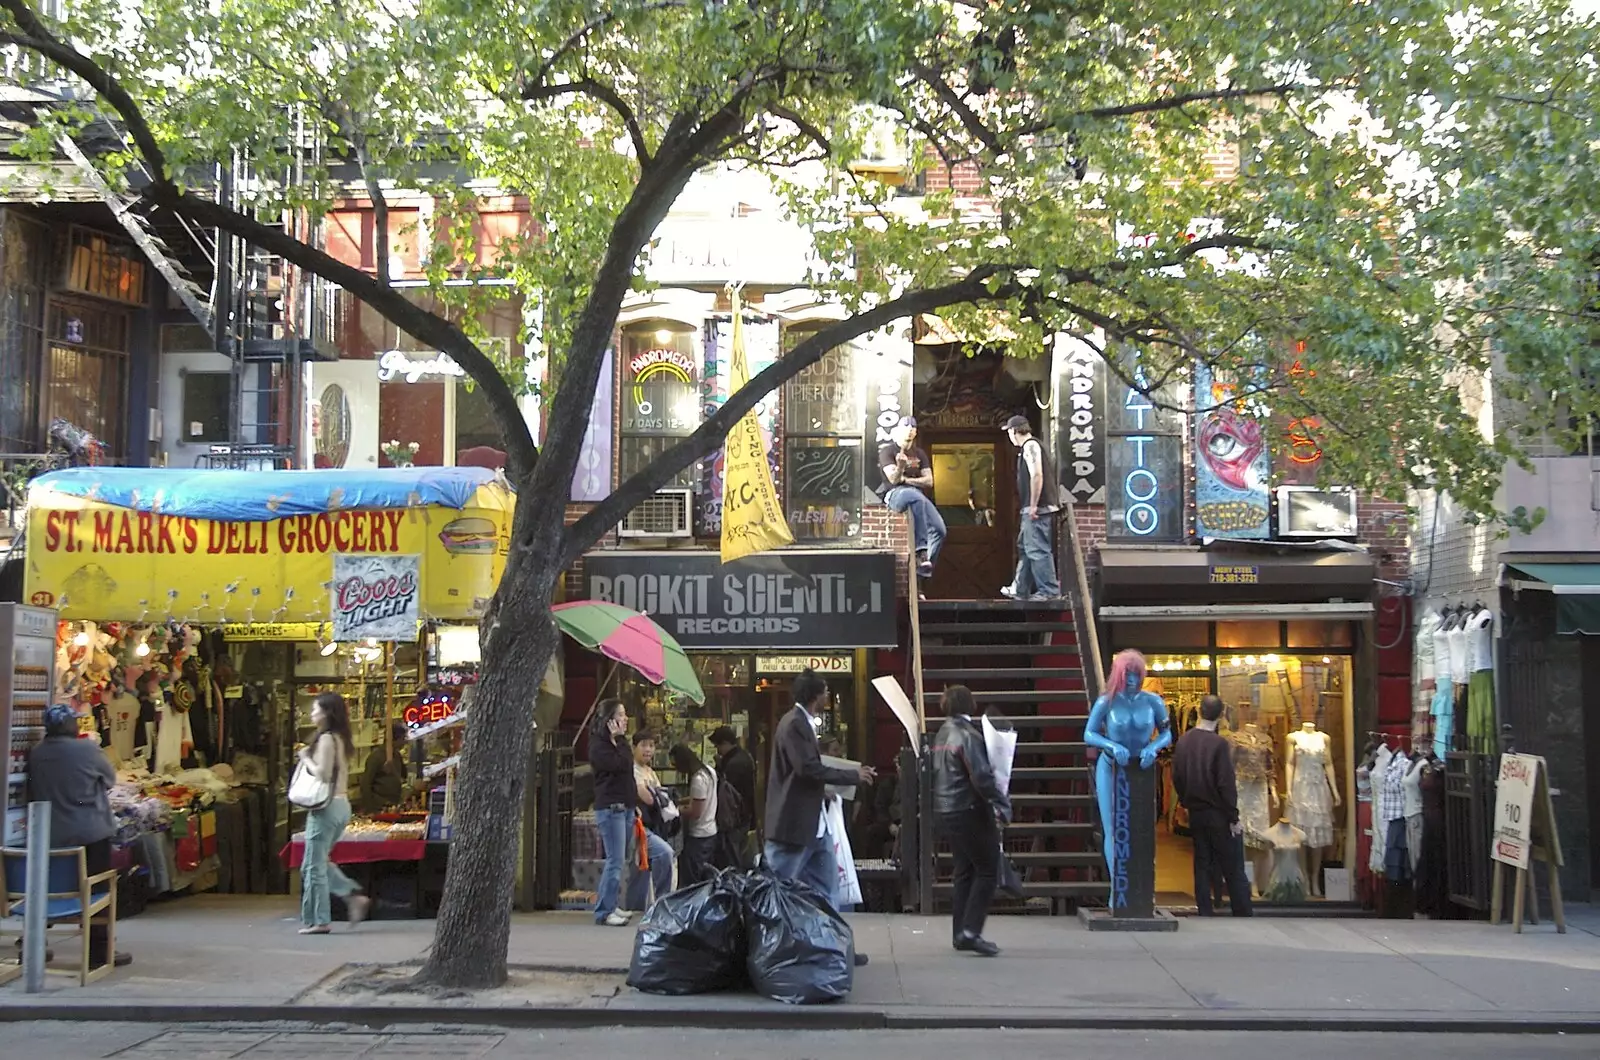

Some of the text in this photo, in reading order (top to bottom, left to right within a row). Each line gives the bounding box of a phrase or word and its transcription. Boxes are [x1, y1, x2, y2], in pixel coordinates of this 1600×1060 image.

[630, 349, 695, 374] ANDROMEDA
[628, 419, 635, 428] 7
[637, 418, 663, 429] DAYS
[1066, 350, 1095, 493] ANDROMEDA
[790, 510, 828, 524] FLESH
[45, 509, 405, 554] ST. MARK'S DELI GROCERY
[336, 571, 416, 614] Coors
[342, 595, 413, 632] LIGHT
[677, 617, 800, 634] RECORDS
[224, 625, 282, 636] SANDWICHES
[1505, 800, 1521, 823] $10
[1114, 769, 1130, 908] ANDROMEDA
